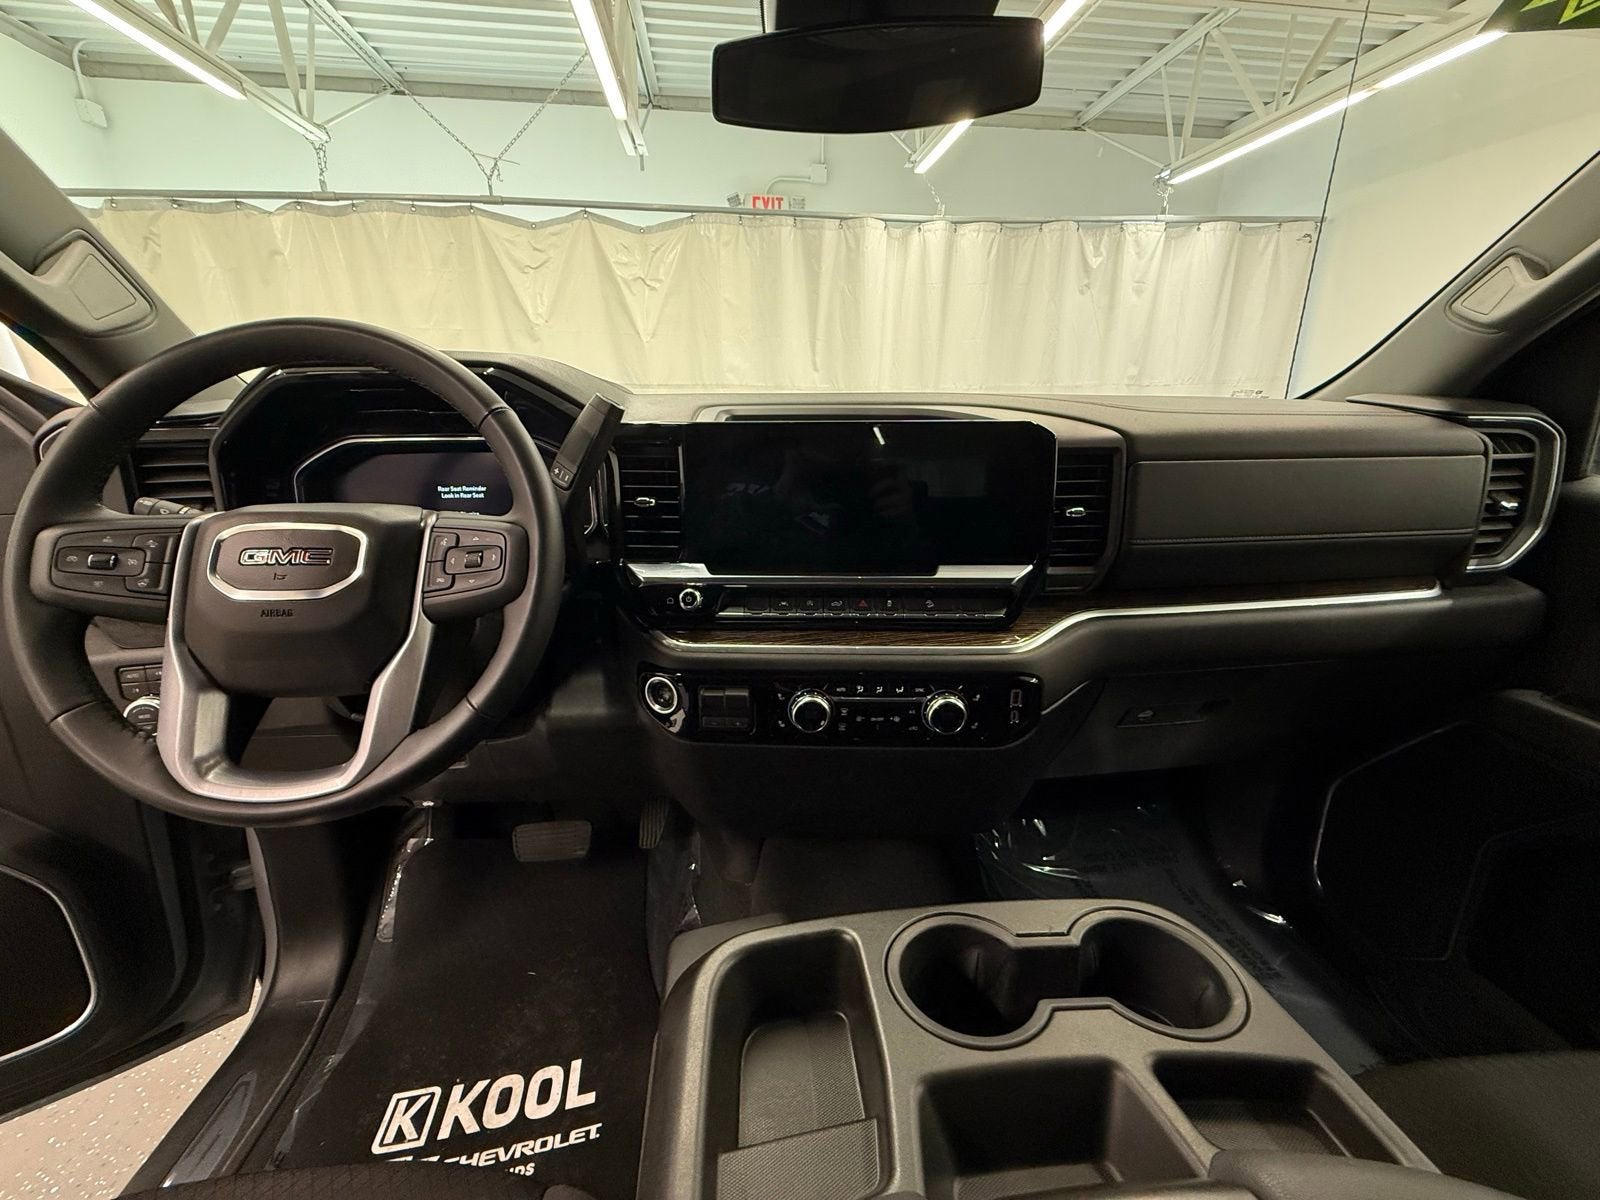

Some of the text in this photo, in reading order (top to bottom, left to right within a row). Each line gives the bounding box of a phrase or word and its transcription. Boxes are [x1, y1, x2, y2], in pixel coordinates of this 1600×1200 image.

[239, 548, 333, 565] GMC
[260, 609, 293, 618] AIRBAG
[436, 1058, 597, 1141] KOOL
